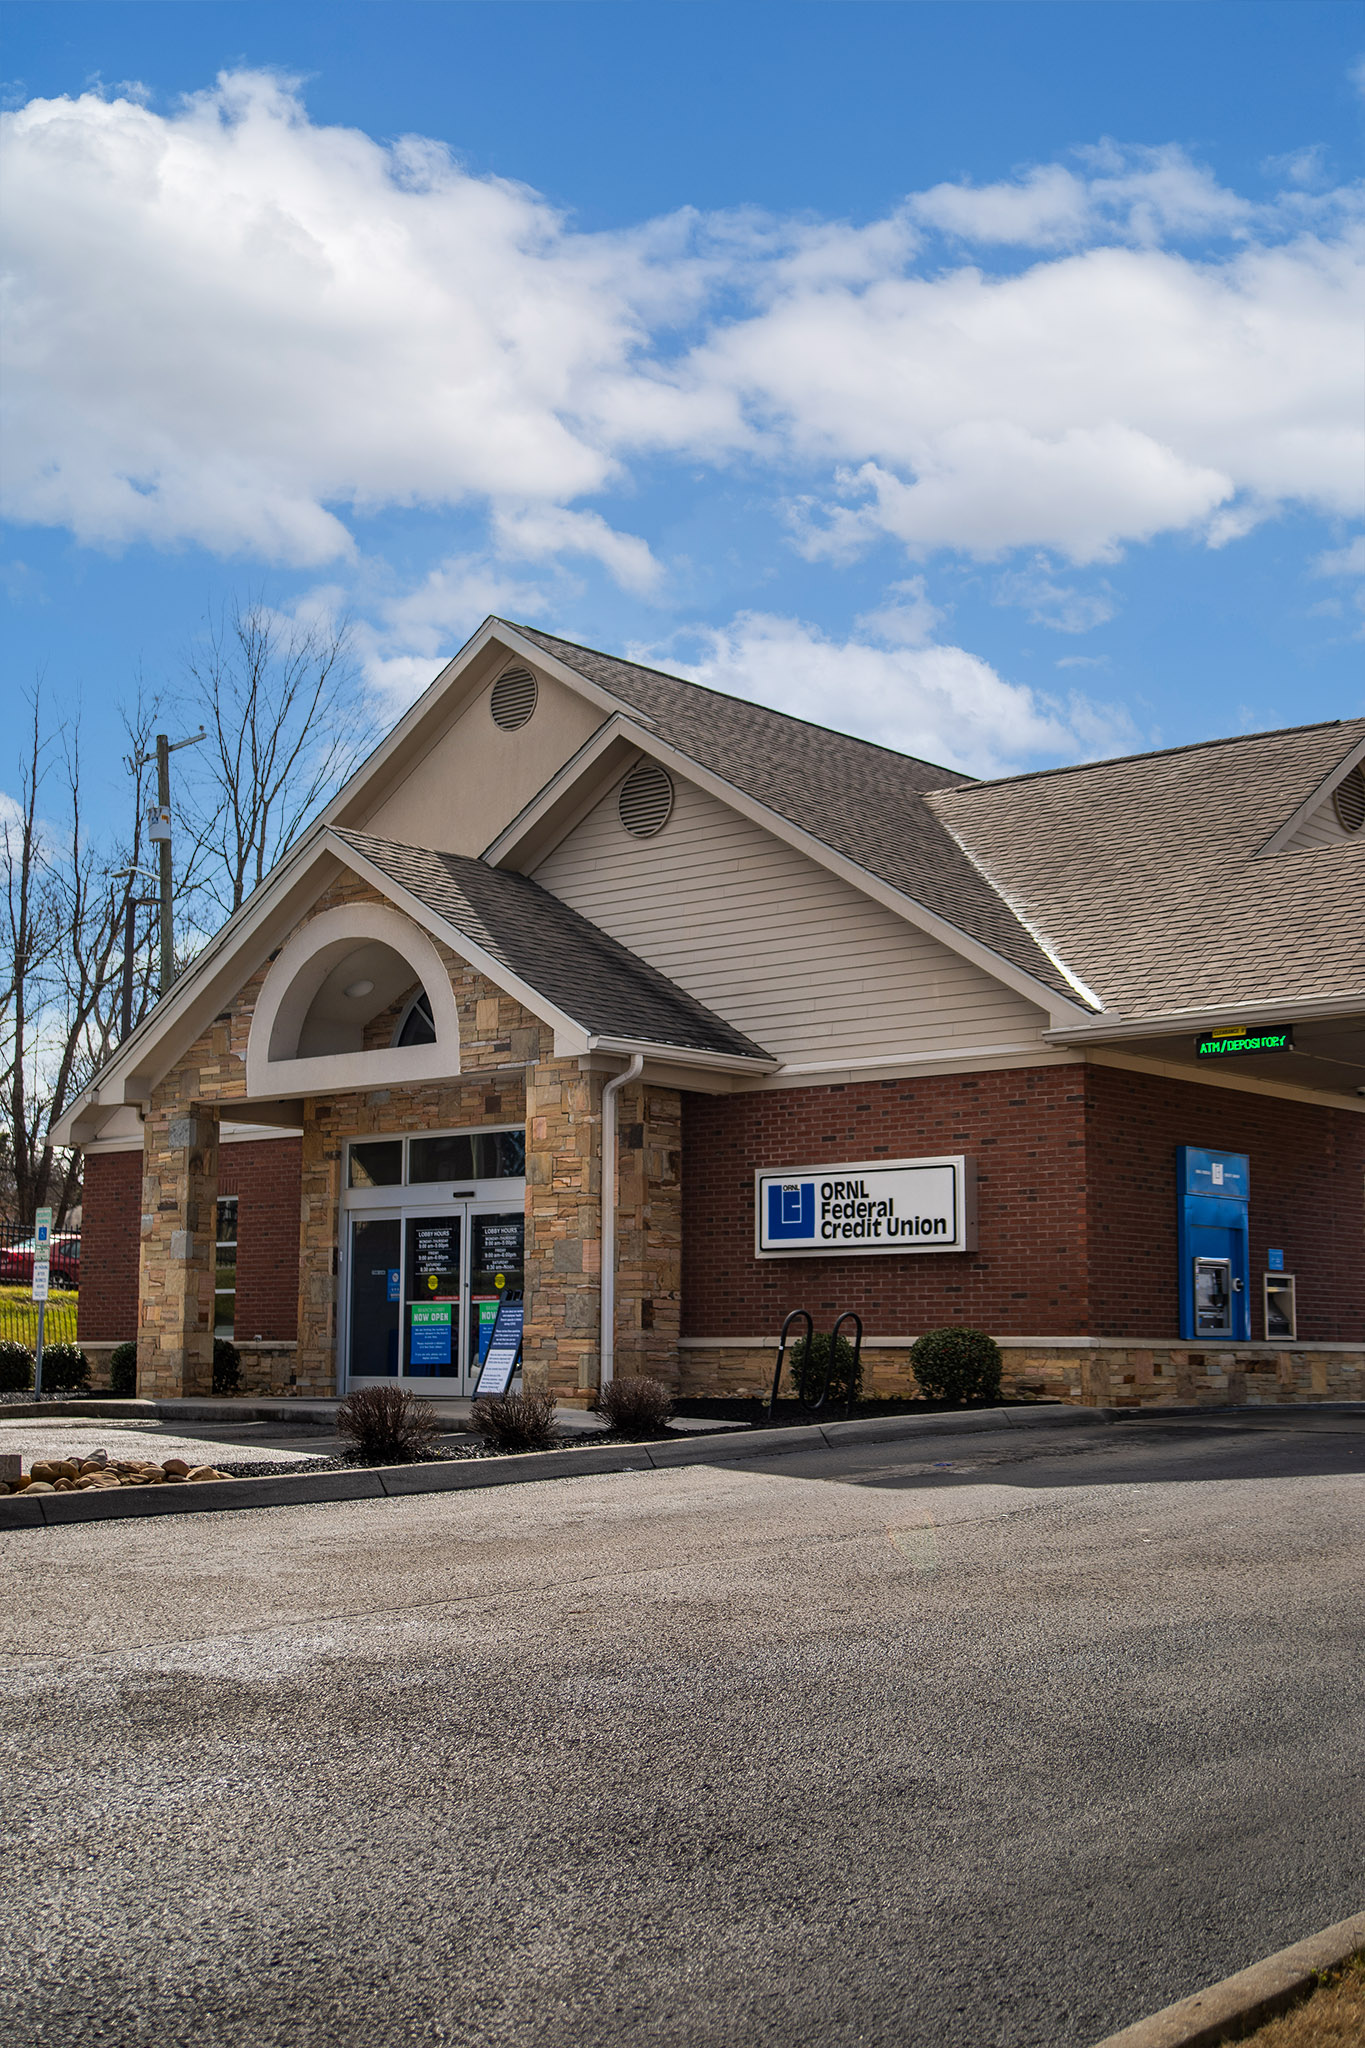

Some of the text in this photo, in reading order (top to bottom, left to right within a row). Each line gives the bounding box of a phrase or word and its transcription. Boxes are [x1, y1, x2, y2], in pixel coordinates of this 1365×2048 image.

[1200, 1035, 1286, 1054] ATM/DEPOSITORY
[821, 1180, 869, 1200] ORNL
[821, 1198, 893, 1220] Federal
[821, 1217, 882, 1239] Credit
[887, 1216, 947, 1236] Union
[414, 1312, 448, 1321] NOW OPEN
